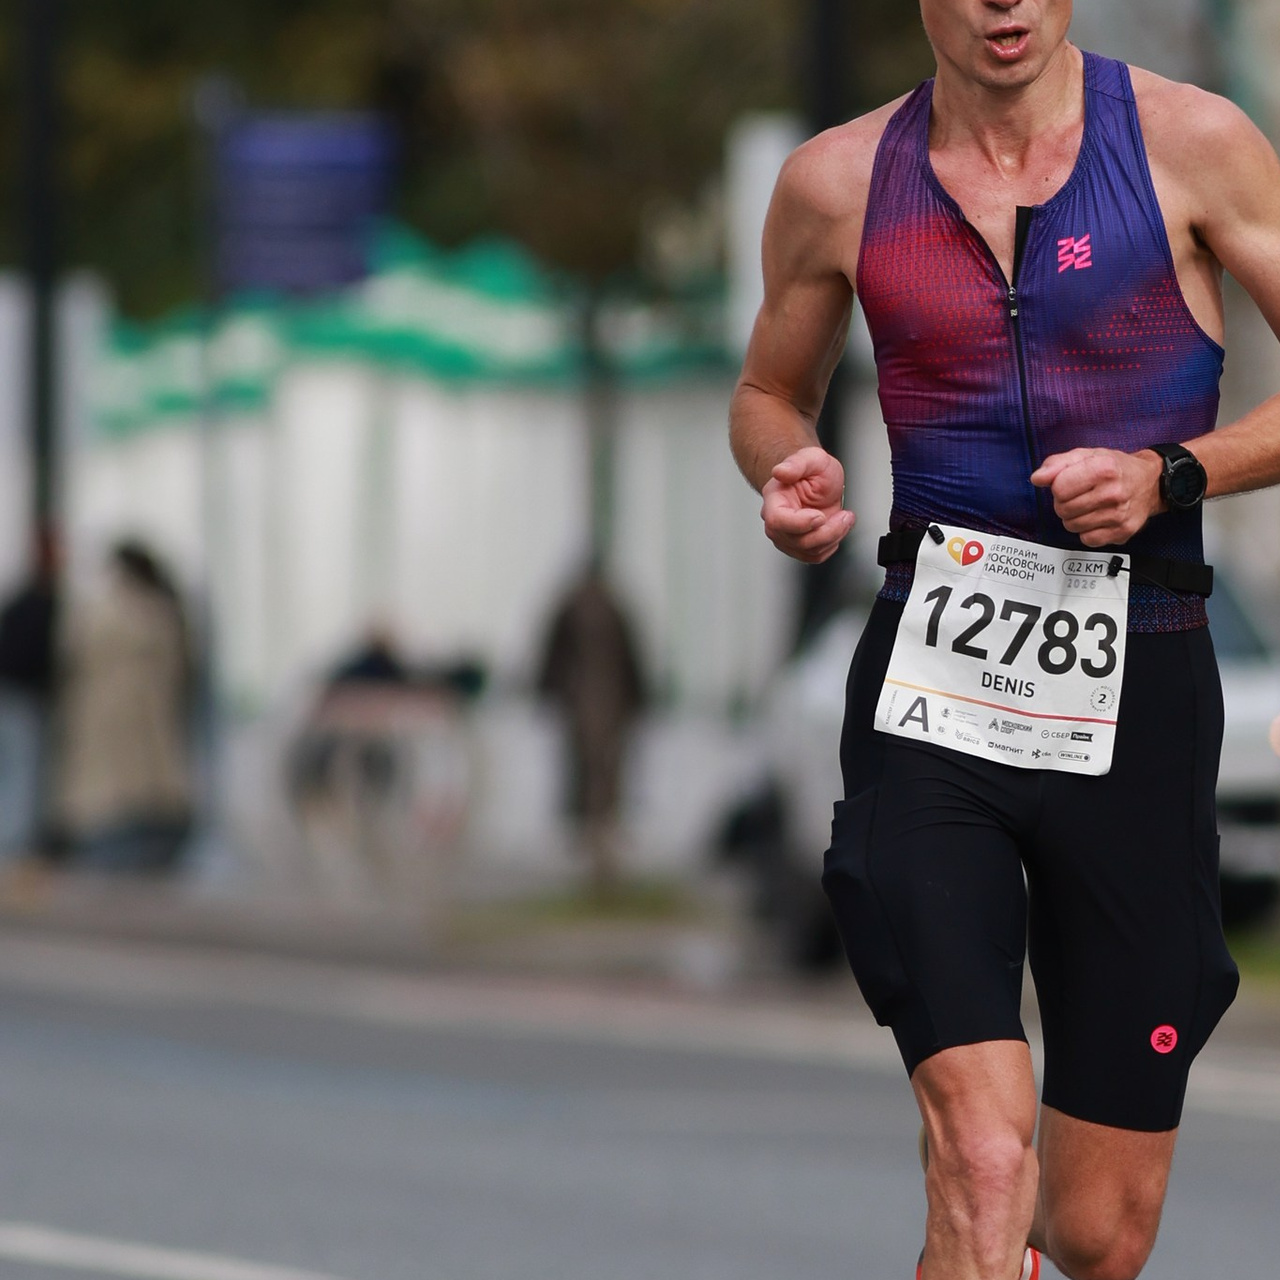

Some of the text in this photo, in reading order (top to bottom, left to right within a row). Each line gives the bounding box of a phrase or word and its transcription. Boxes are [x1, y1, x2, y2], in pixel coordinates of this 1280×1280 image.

[924, 585, 1118, 679] 12783
[981, 672, 1036, 698] DENIS
[1098, 693, 1107, 704] 2
[898, 696, 929, 733] A
[1051, 731, 1070, 739] СБЕР
